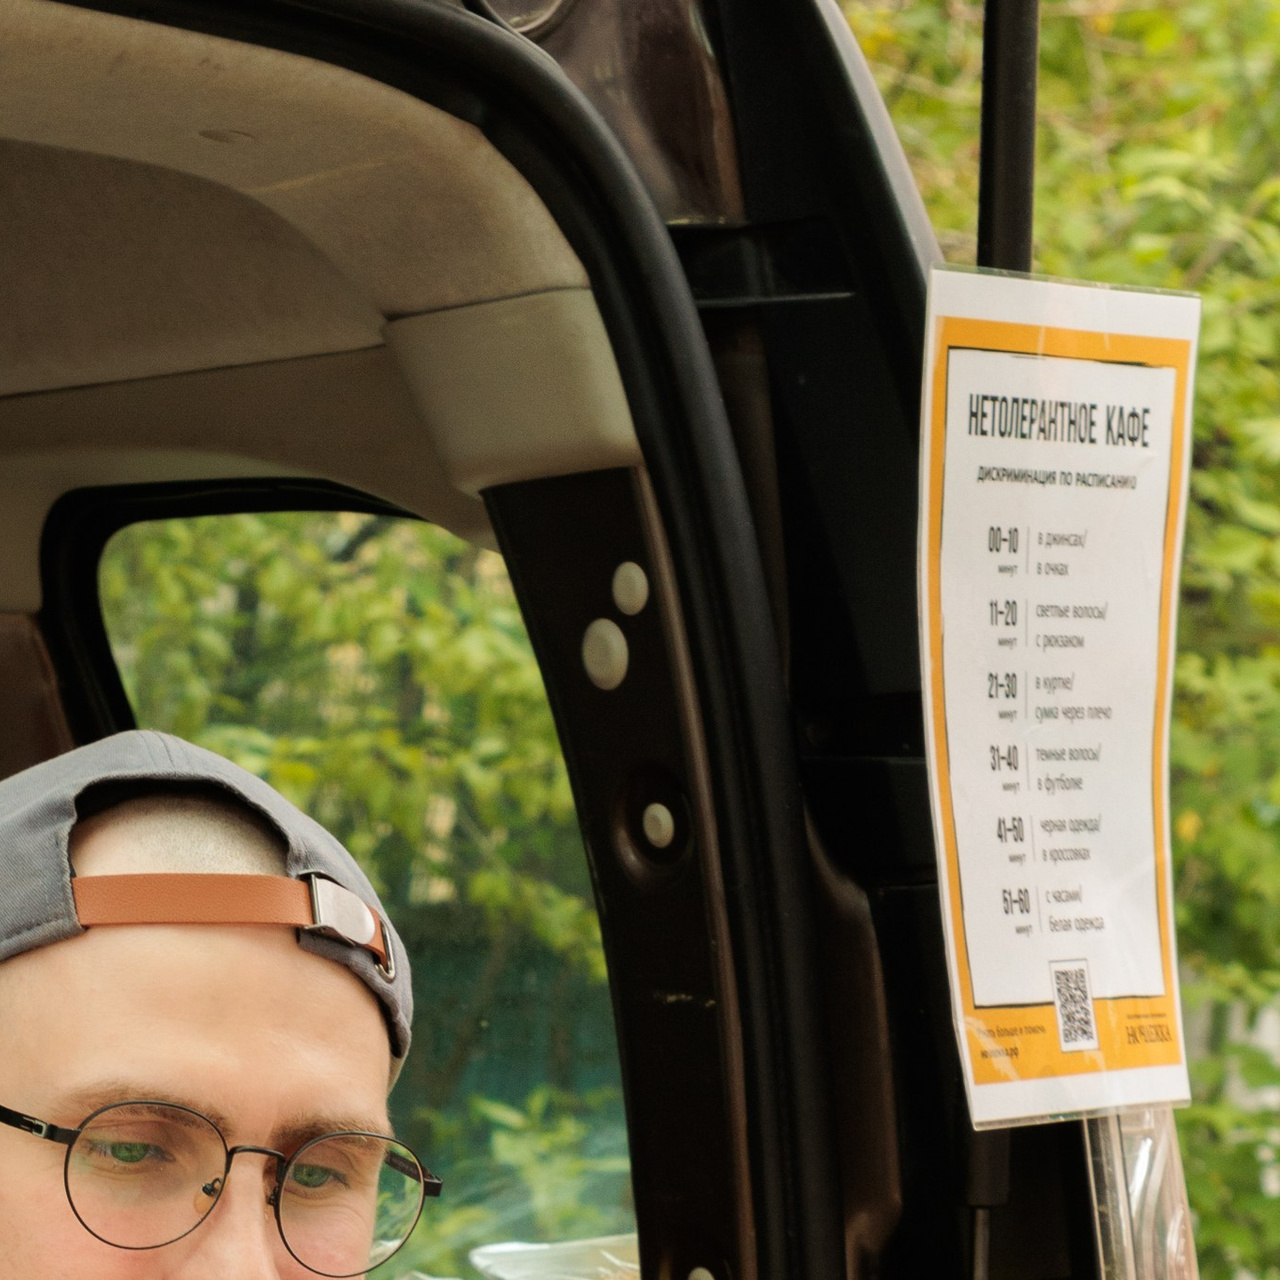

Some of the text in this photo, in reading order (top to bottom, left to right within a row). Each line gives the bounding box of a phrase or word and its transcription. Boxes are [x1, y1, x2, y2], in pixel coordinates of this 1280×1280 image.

[968, 393, 1150, 447] НЕТОЛЕРАНТНОЕ КАФЕ
[977, 465, 1056, 487] ДИСКРИМИНАЦИЯ
[1060, 471, 1073, 486] ПО
